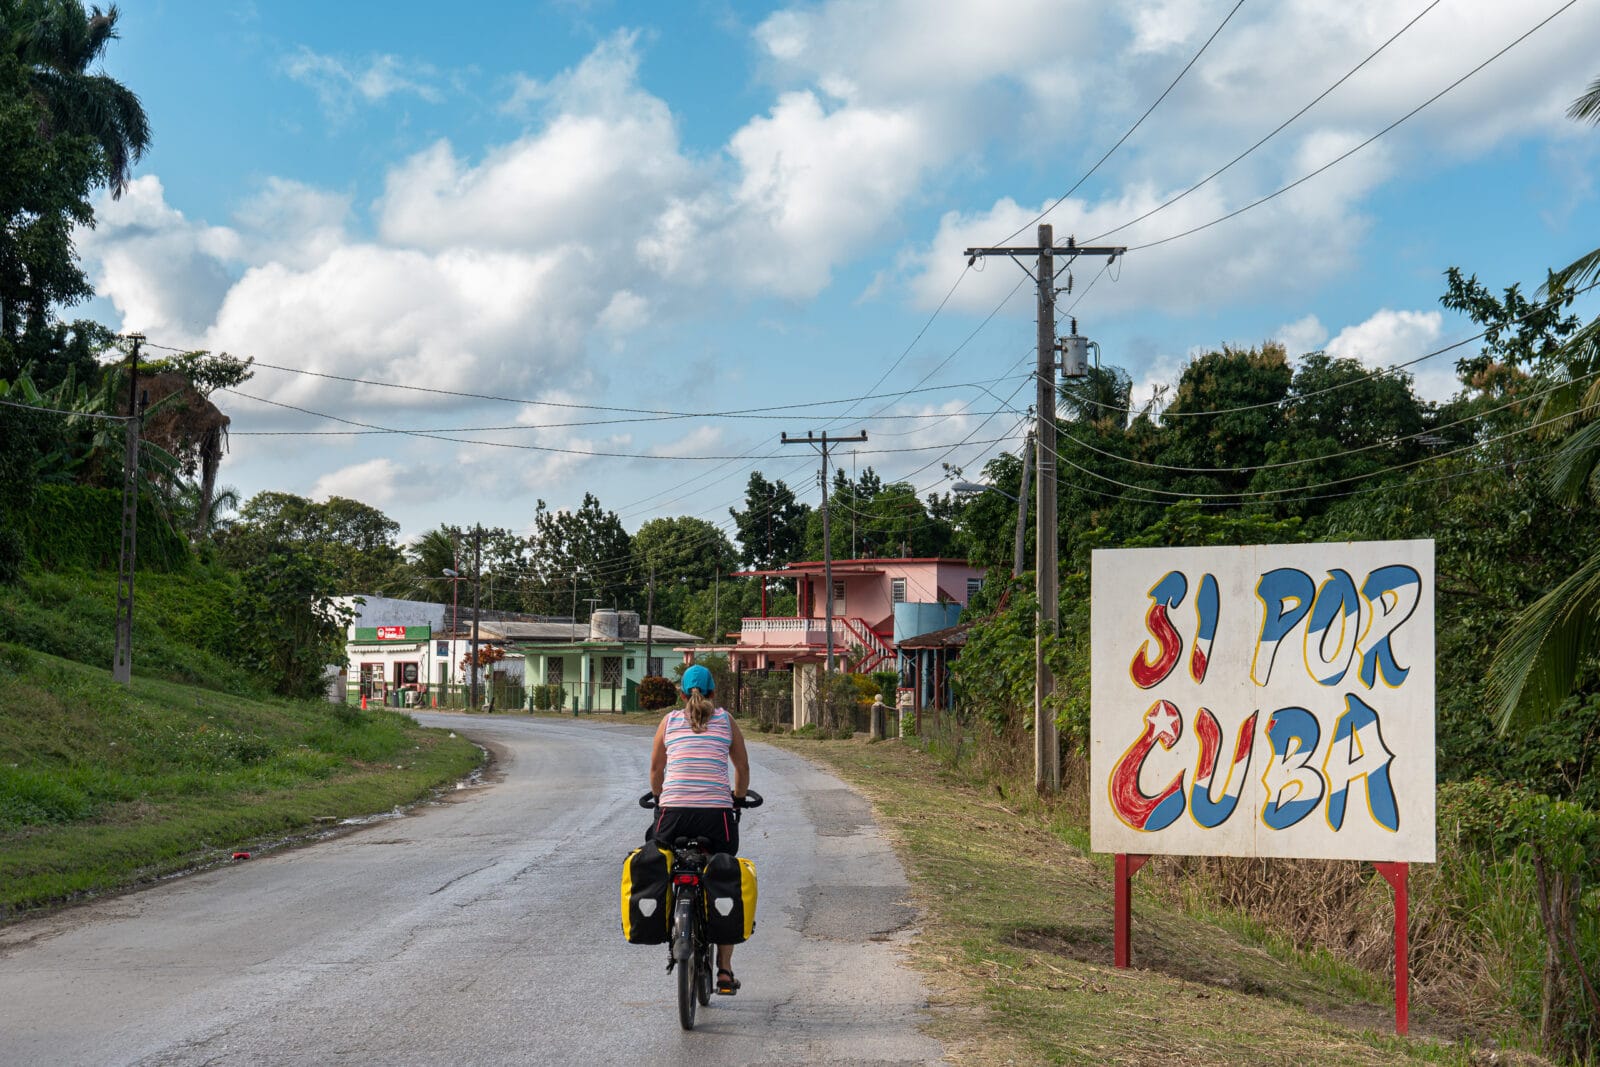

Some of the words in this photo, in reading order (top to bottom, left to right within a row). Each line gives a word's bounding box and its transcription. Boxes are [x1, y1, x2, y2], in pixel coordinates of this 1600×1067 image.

[1130, 571, 1220, 690] SI
[1250, 564, 1422, 690] POR
[1108, 692, 1400, 832] CUBA
